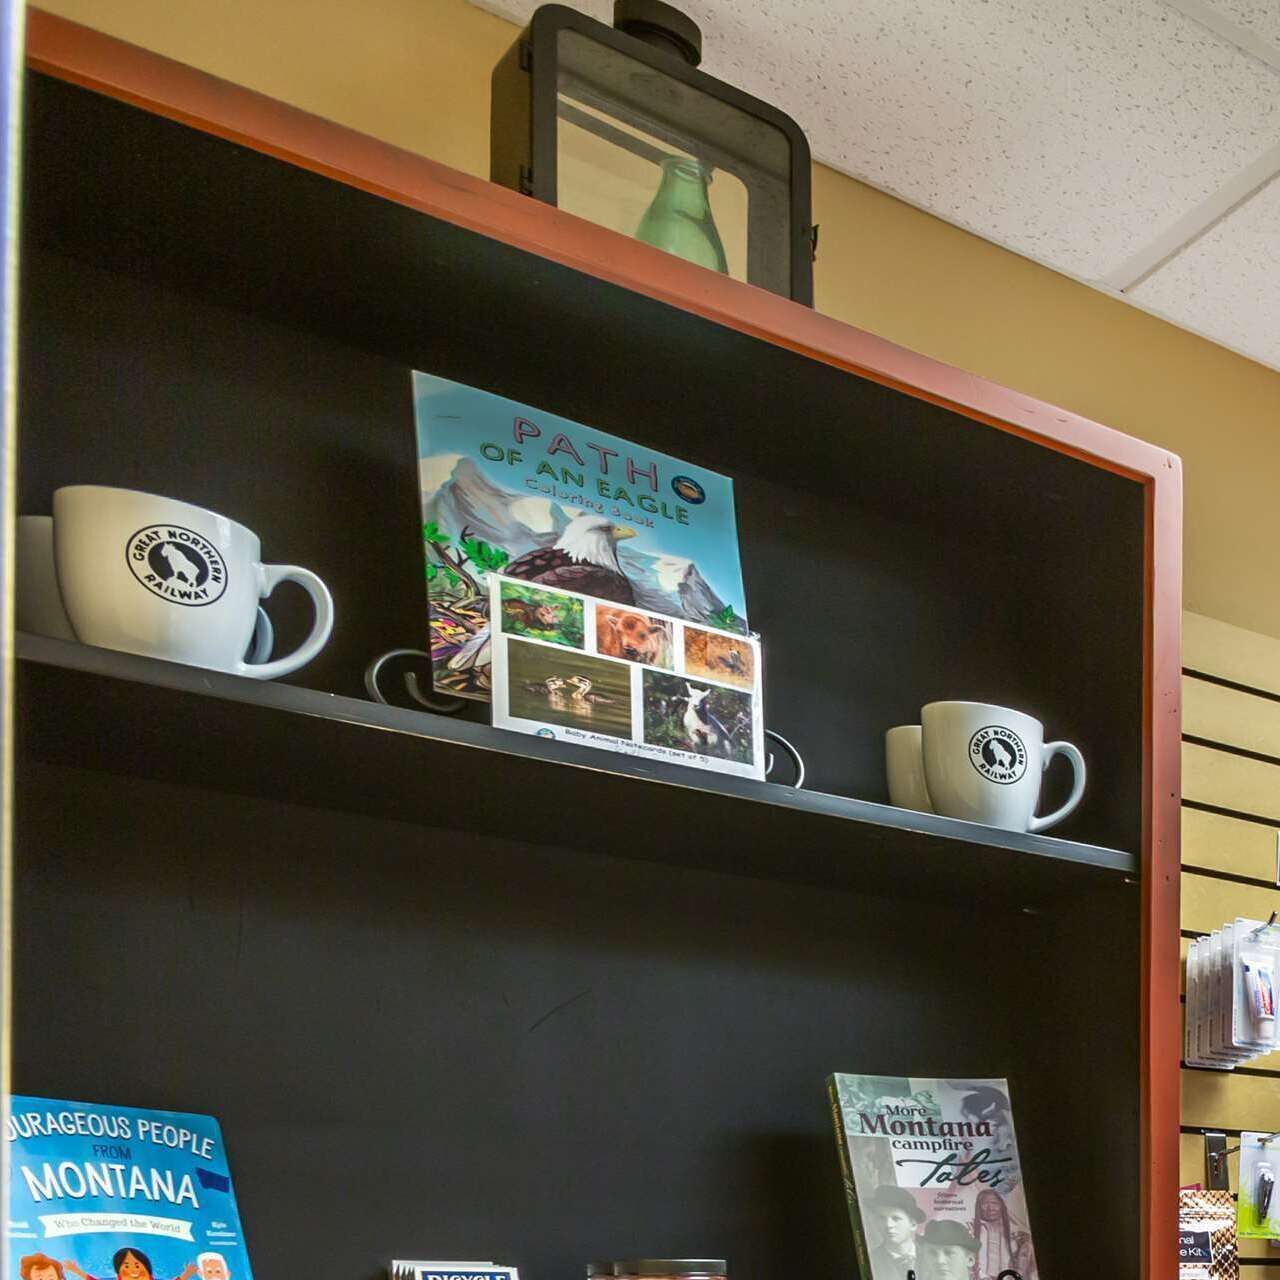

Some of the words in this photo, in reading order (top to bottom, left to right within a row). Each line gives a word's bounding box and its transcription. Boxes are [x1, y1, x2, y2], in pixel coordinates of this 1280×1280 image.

[514, 416, 659, 493] PATH
[480, 442, 524, 467] OF
[535, 460, 585, 488] AN
[597, 478, 690, 526] EAGLE
[133, 530, 163, 562] GREAT
[167, 529, 223, 584] NORTHERN
[144, 573, 209, 601] RAILWAY
[564, 728, 588, 740] Baby
[589, 734, 620, 746] Animal
[972, 730, 990, 755] GREAT
[993, 729, 1024, 766] NORTHERN
[979, 763, 1017, 780] RAILWAY
[886, 1104, 928, 1117] More
[858, 1112, 994, 1137] Montana
[92, 1144, 132, 1161] FROM
[137, 1119, 216, 1160] PEOPLE
[892, 1138, 974, 1153] campfire
[20, 1160, 200, 1209] MONTANA
[80, 1217, 128, 1230] Changed
[149, 1220, 181, 1234] World
